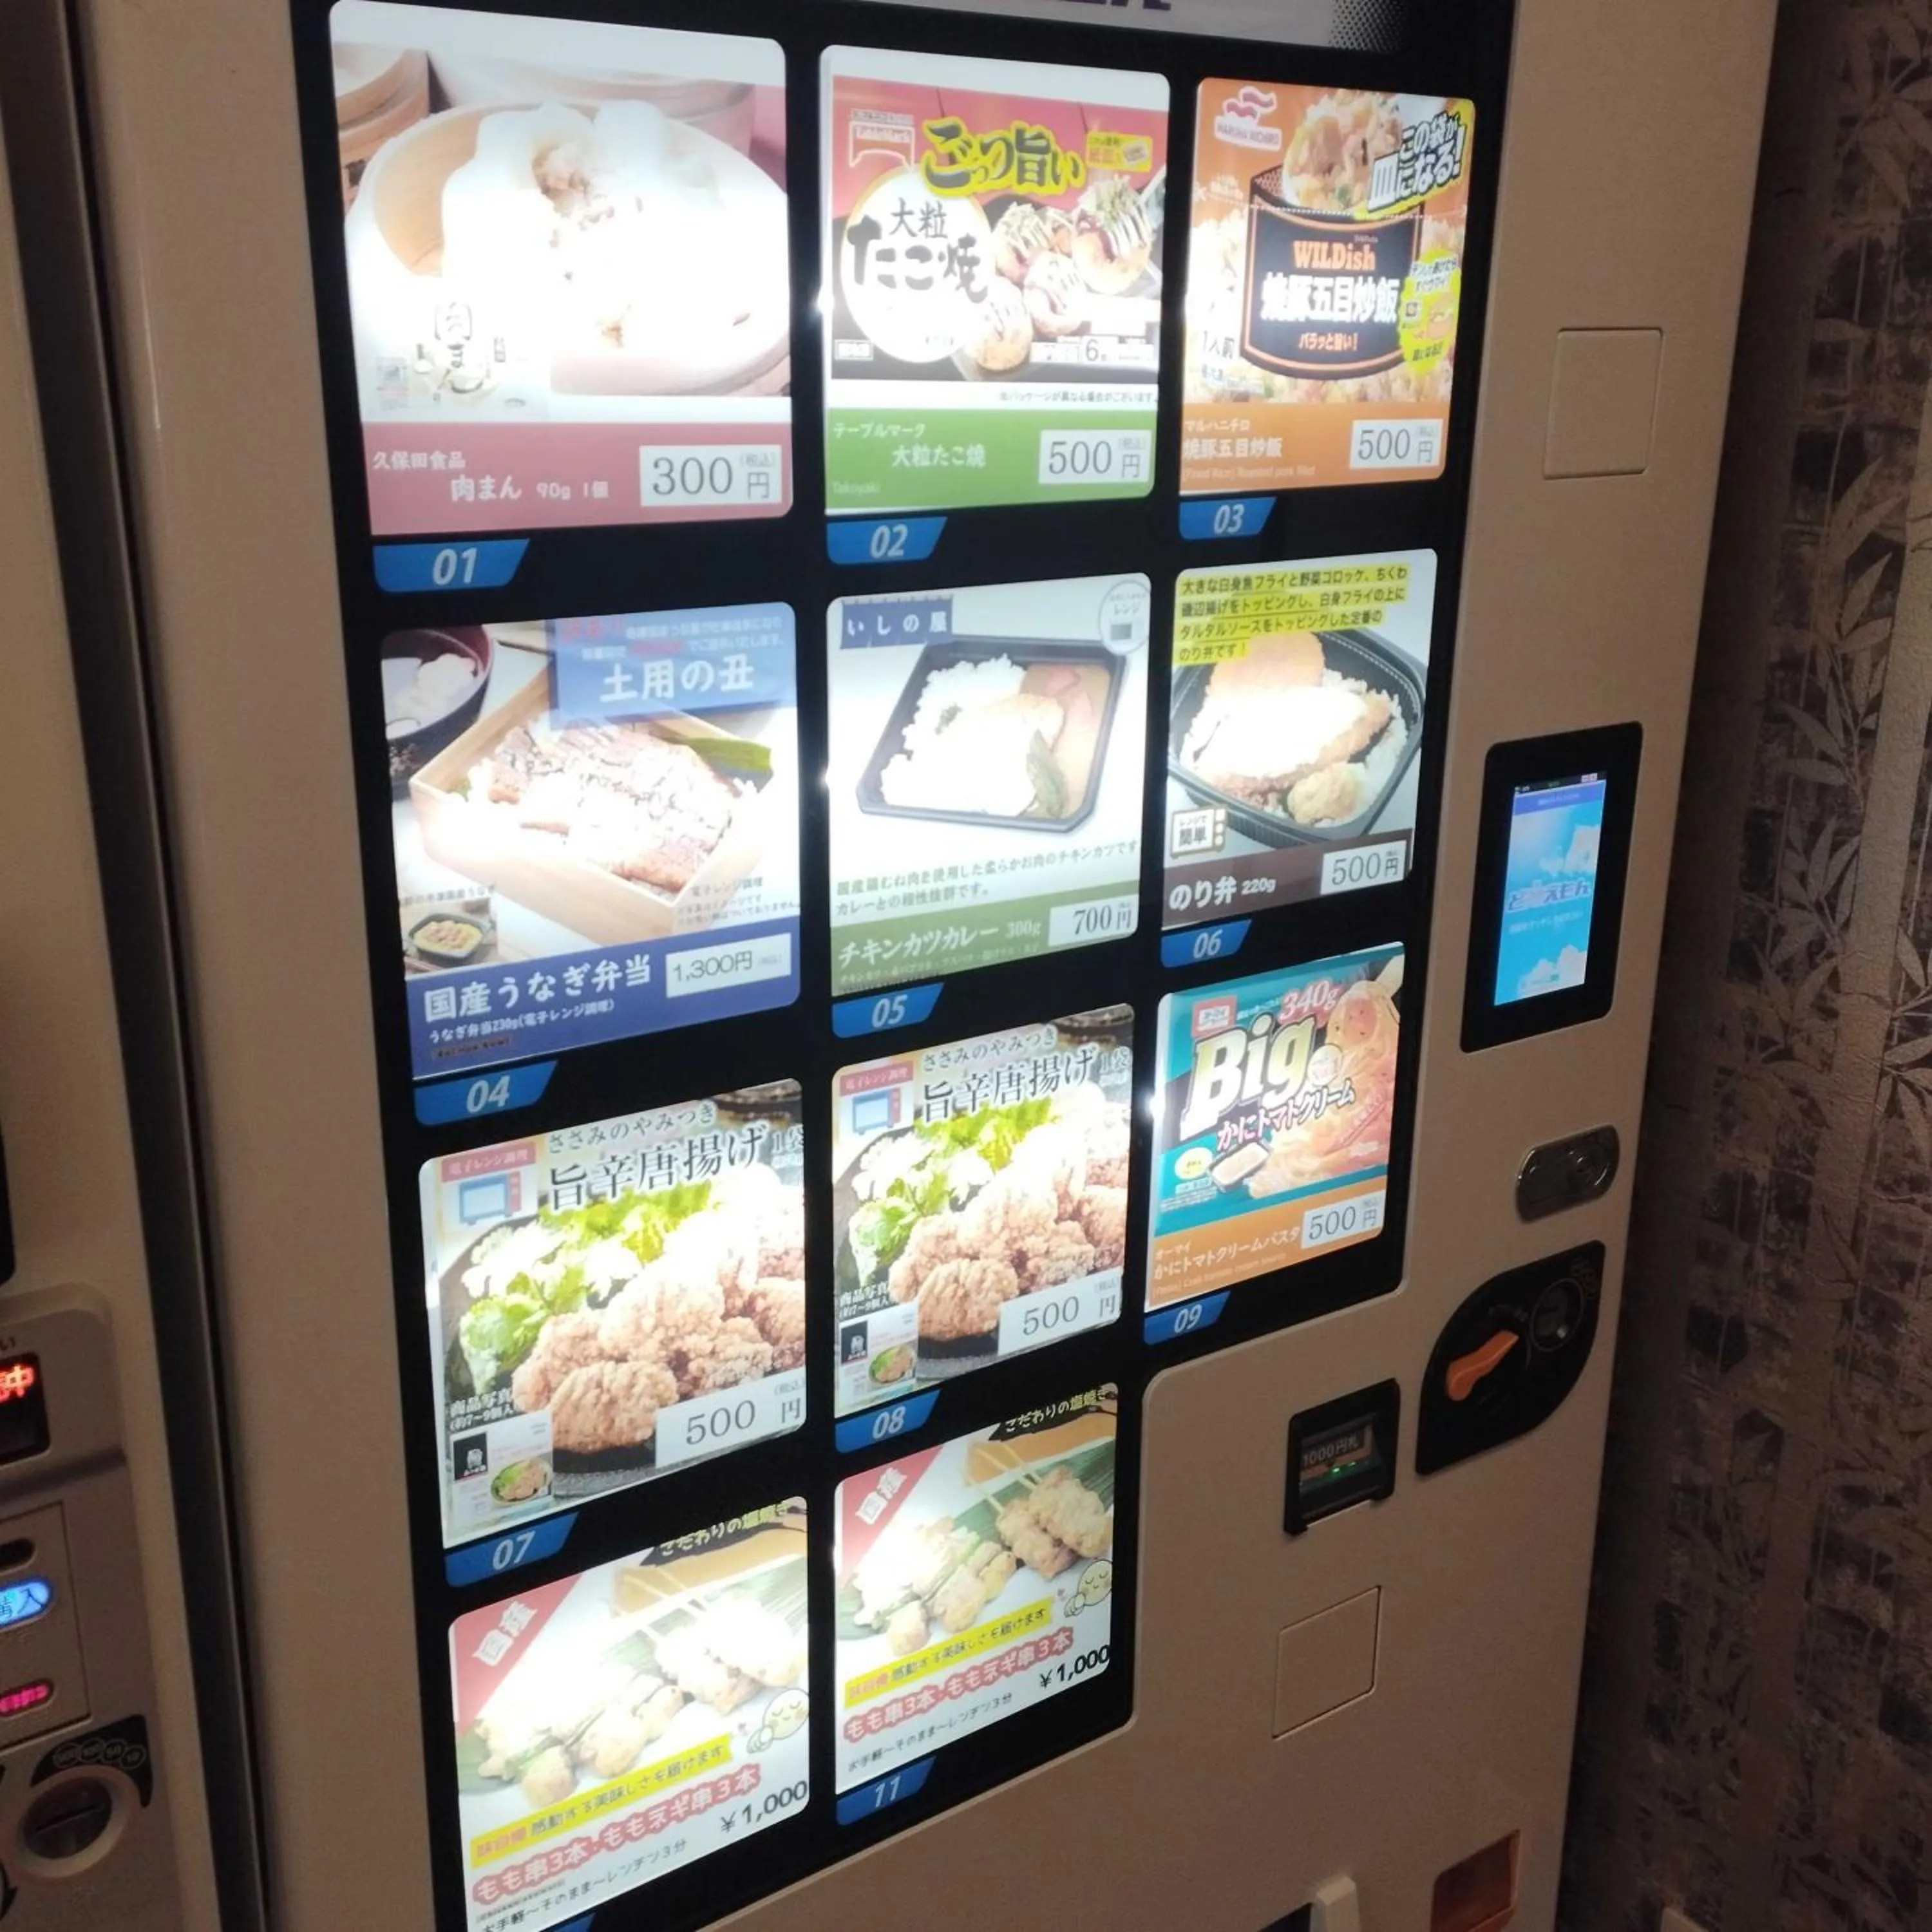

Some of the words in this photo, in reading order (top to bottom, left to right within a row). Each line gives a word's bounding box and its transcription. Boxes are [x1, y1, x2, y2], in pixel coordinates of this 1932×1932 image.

[922, 118, 1082, 192] ごっつ旨い
[890, 198, 948, 240] 大粒
[846, 213, 989, 303] たこ焼
[1293, 240, 1376, 270] WILDish
[833, 422, 926, 439] テーブルマーク
[1184, 419, 1250, 431] マルハニチロ
[373, 451, 466, 470] 久保田食品
[892, 444, 987, 468] 大粒たこ焼
[450, 474, 522, 502] 肉まん
[1214, 504, 1245, 535] 03
[870, 524, 909, 558] 02
[432, 547, 478, 585] 01
[600, 653, 755, 703] 土用の丑
[1169, 876, 1237, 911] のり弁
[1241, 878, 1276, 895] 220g
[838, 926, 999, 969] チキンカツカレー
[1193, 929, 1222, 958] 06
[672, 950, 753, 983] 1,300円
[423, 953, 652, 1024] 国産うなぎ弁当
[872, 994, 908, 1028] 05
[923, 1027, 1056, 1070] ささみのやみつき
[466, 1075, 510, 1113] 04
[923, 1047, 1096, 1121] 旨辛唐揚げ
[1180, 1012, 1318, 1142] Big
[549, 1102, 717, 1155] ささみのやみつき
[1217, 1078, 1356, 1151] かにトマトクリーム
[550, 1123, 768, 1211] 旨辛唐揚げ
[1154, 1225, 1301, 1280] かにトマトクリームパスタ
[1173, 1304, 1203, 1333] 09
[872, 1405, 906, 1439] 08
[492, 1530, 536, 1571] 07
[875, 1776, 902, 1808] 11
